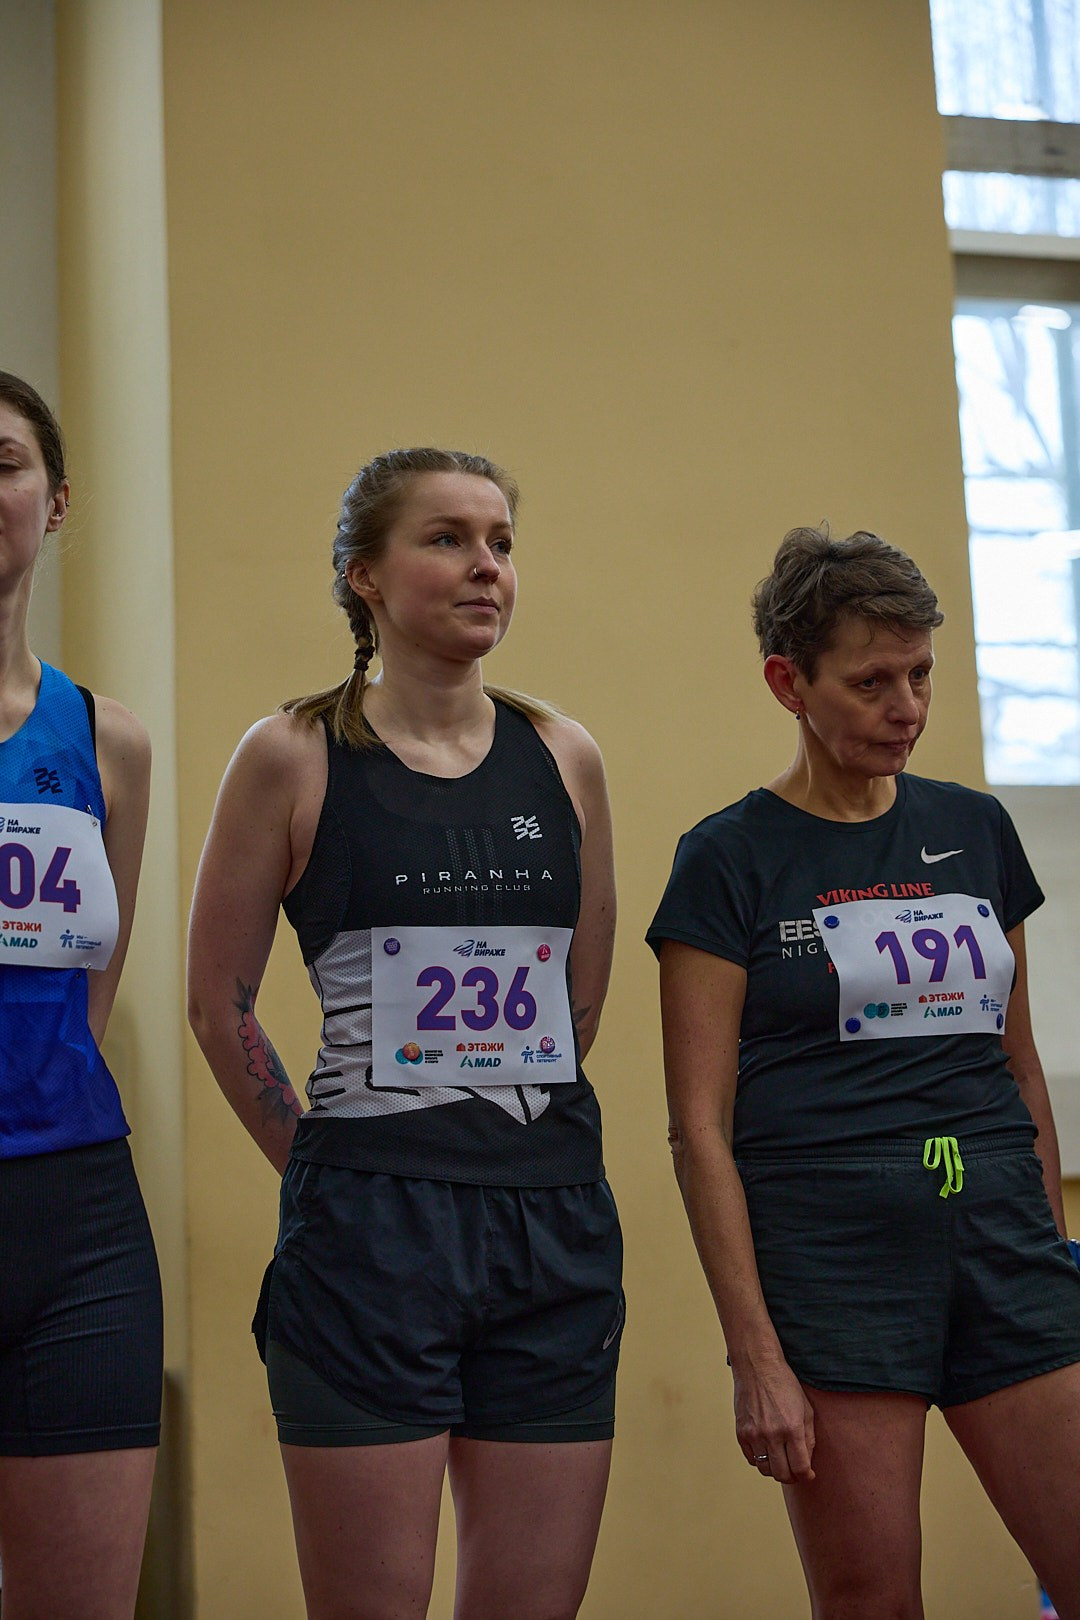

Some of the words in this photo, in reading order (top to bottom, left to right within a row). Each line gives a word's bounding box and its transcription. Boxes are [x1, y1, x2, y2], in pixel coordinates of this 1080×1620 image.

[7, 818, 19, 827] НА
[6, 826, 41, 835] ВИРАЖЕ
[0, 842, 81, 914] 04
[395, 869, 553, 885] PIRANHA
[423, 884, 489, 894] RUNNING
[816, 883, 889, 906] VIKING
[891, 882, 935, 897] LINE
[914, 912, 944, 921] ВИРАЖЕ
[474, 948, 506, 957] ВИРАЖЕ
[875, 924, 987, 985] 191
[416, 965, 537, 1031] 236
